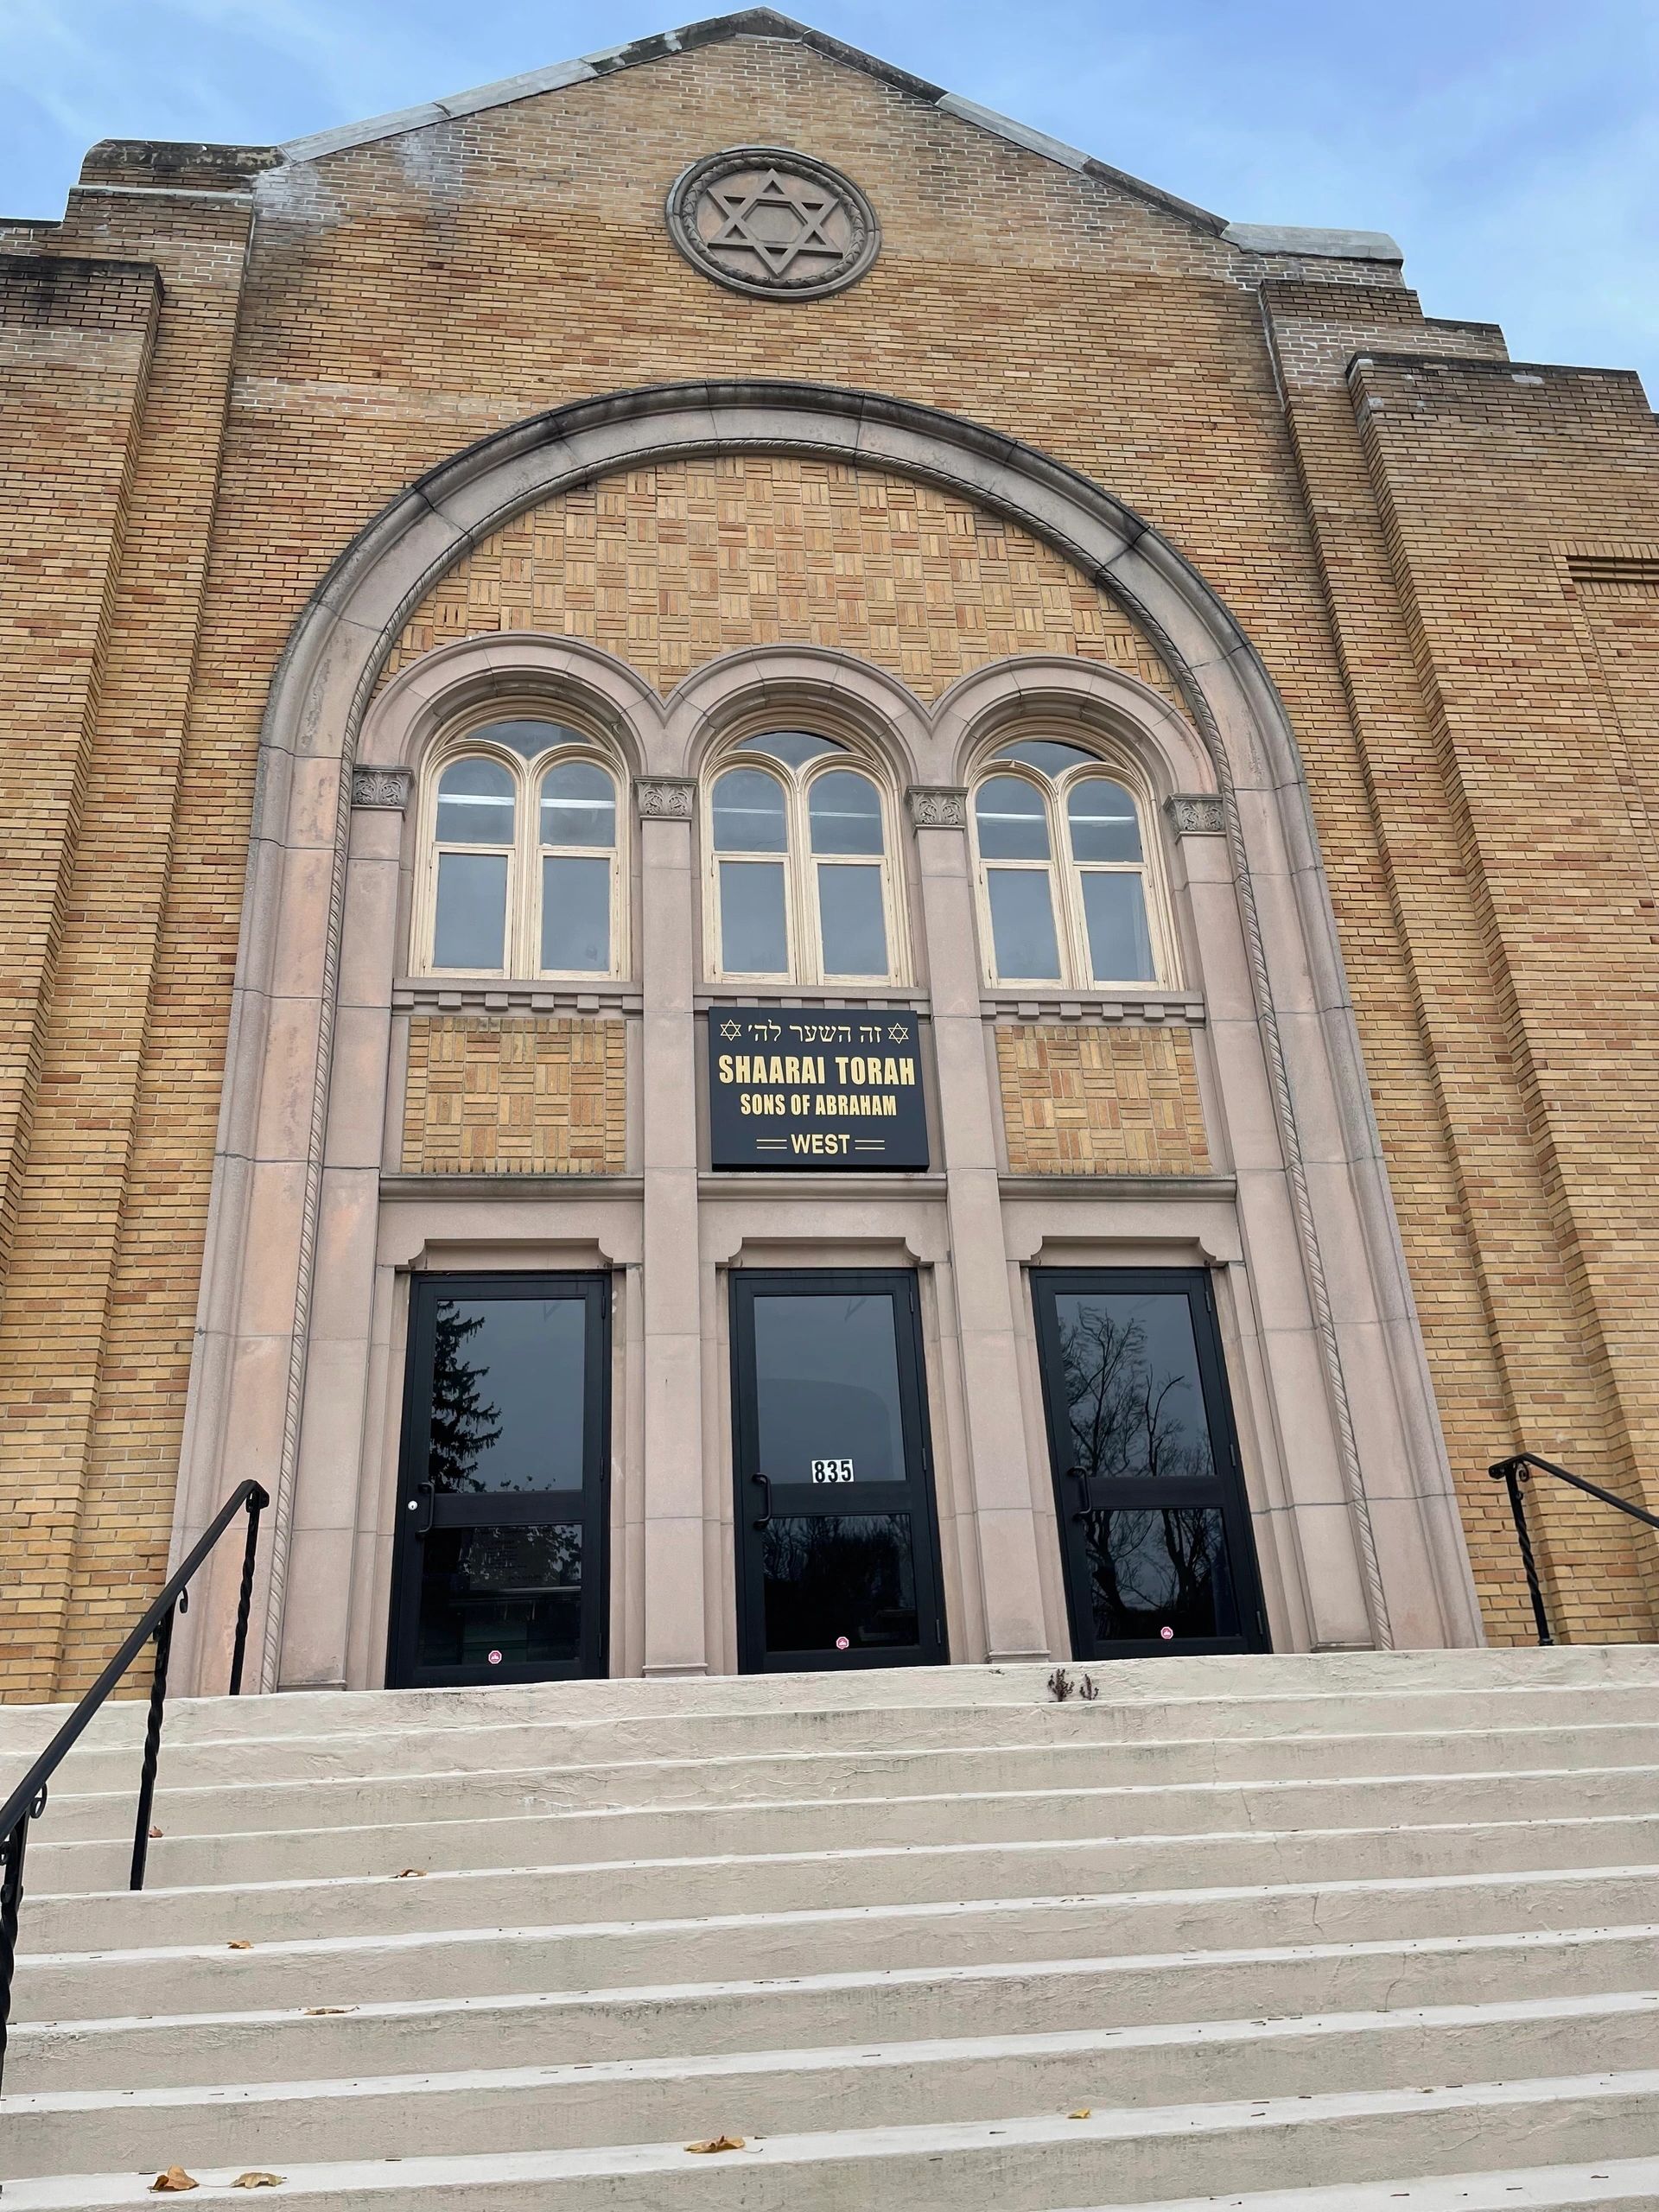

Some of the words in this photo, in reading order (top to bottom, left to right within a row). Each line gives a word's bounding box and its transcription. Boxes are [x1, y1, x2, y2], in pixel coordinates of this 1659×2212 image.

[789, 1025, 852, 1043] השער
[860, 1026, 882, 1043] זה
[718, 1054, 826, 1084] SHAARAI
[835, 1056, 916, 1085] TORAH
[740, 1093, 786, 1116] SONS
[791, 1094, 810, 1116] OF
[815, 1094, 897, 1116] ABRAHAM
[791, 1134, 850, 1154] WEST
[814, 1460, 852, 1484] 835
